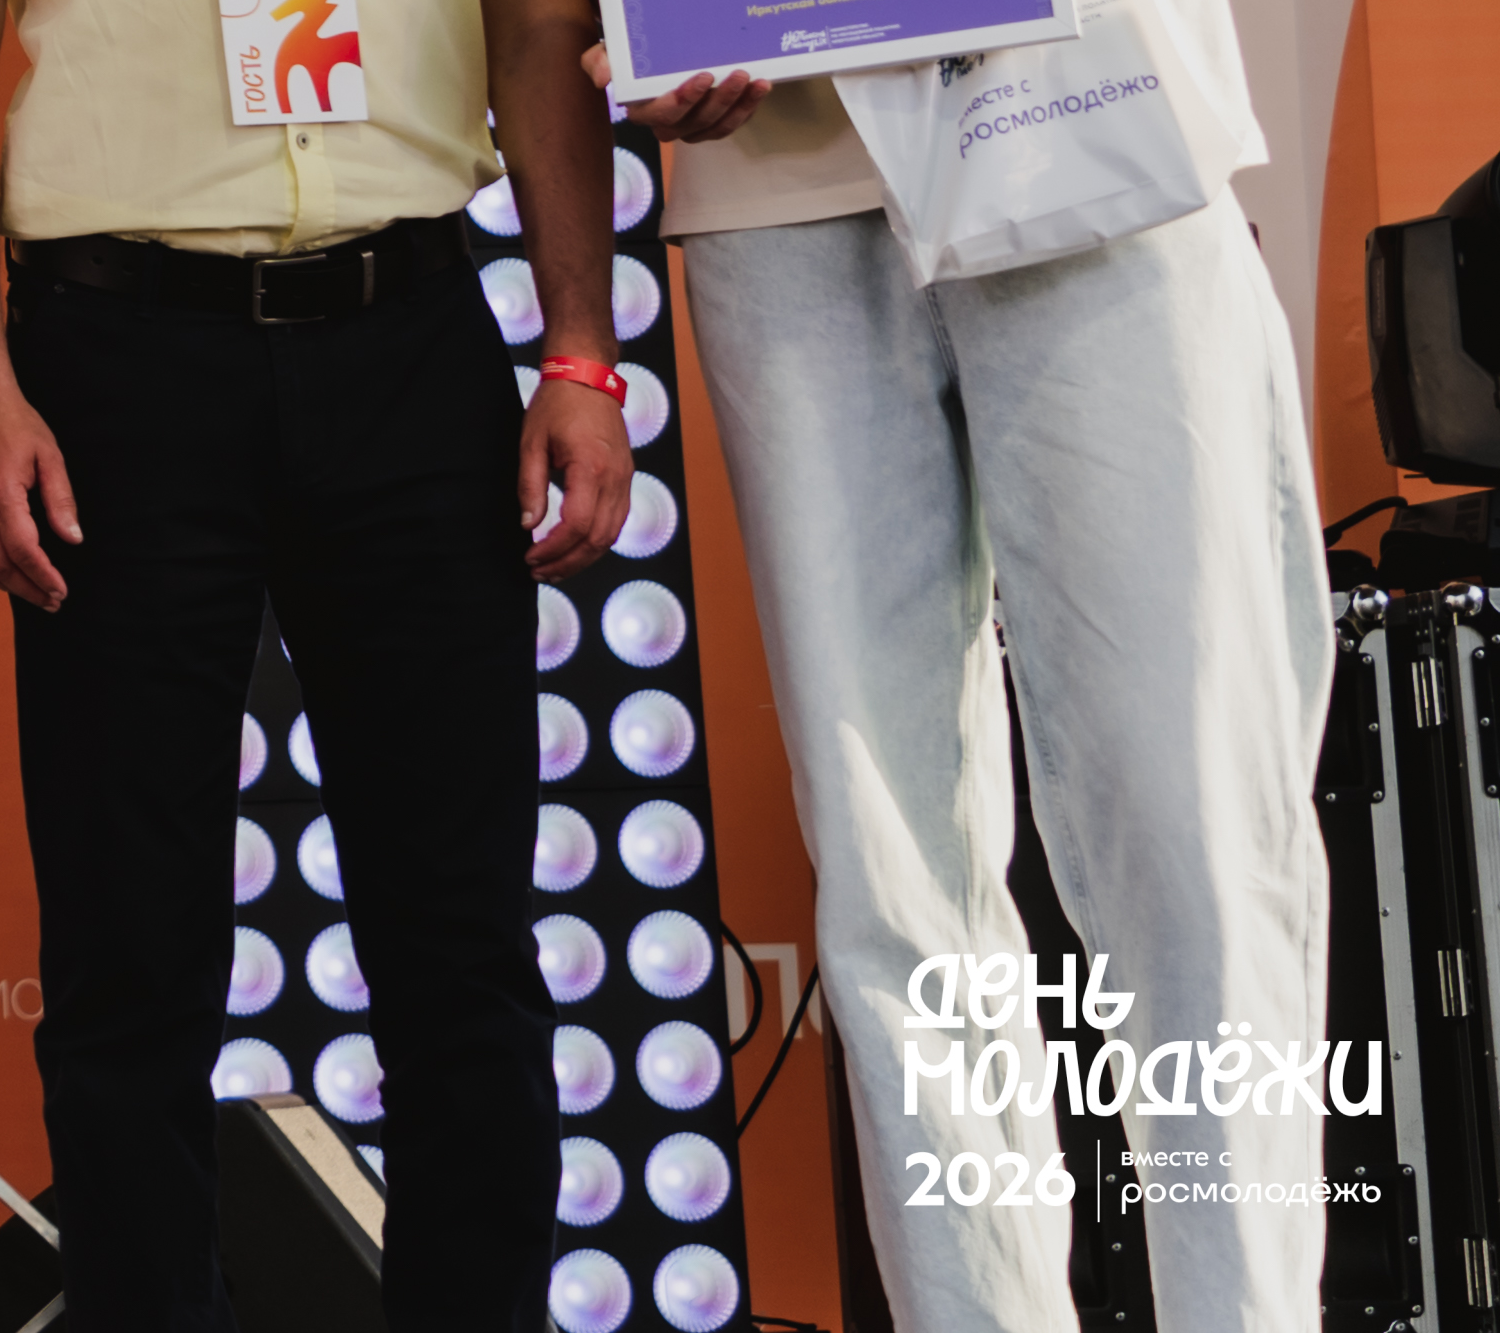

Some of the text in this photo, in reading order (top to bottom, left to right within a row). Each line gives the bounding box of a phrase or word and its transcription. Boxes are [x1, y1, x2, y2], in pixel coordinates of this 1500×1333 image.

[239, 45, 267, 113] ГОСТЬ
[1020, 79, 1032, 94] с
[958, 74, 1159, 160] росмолодёжь
